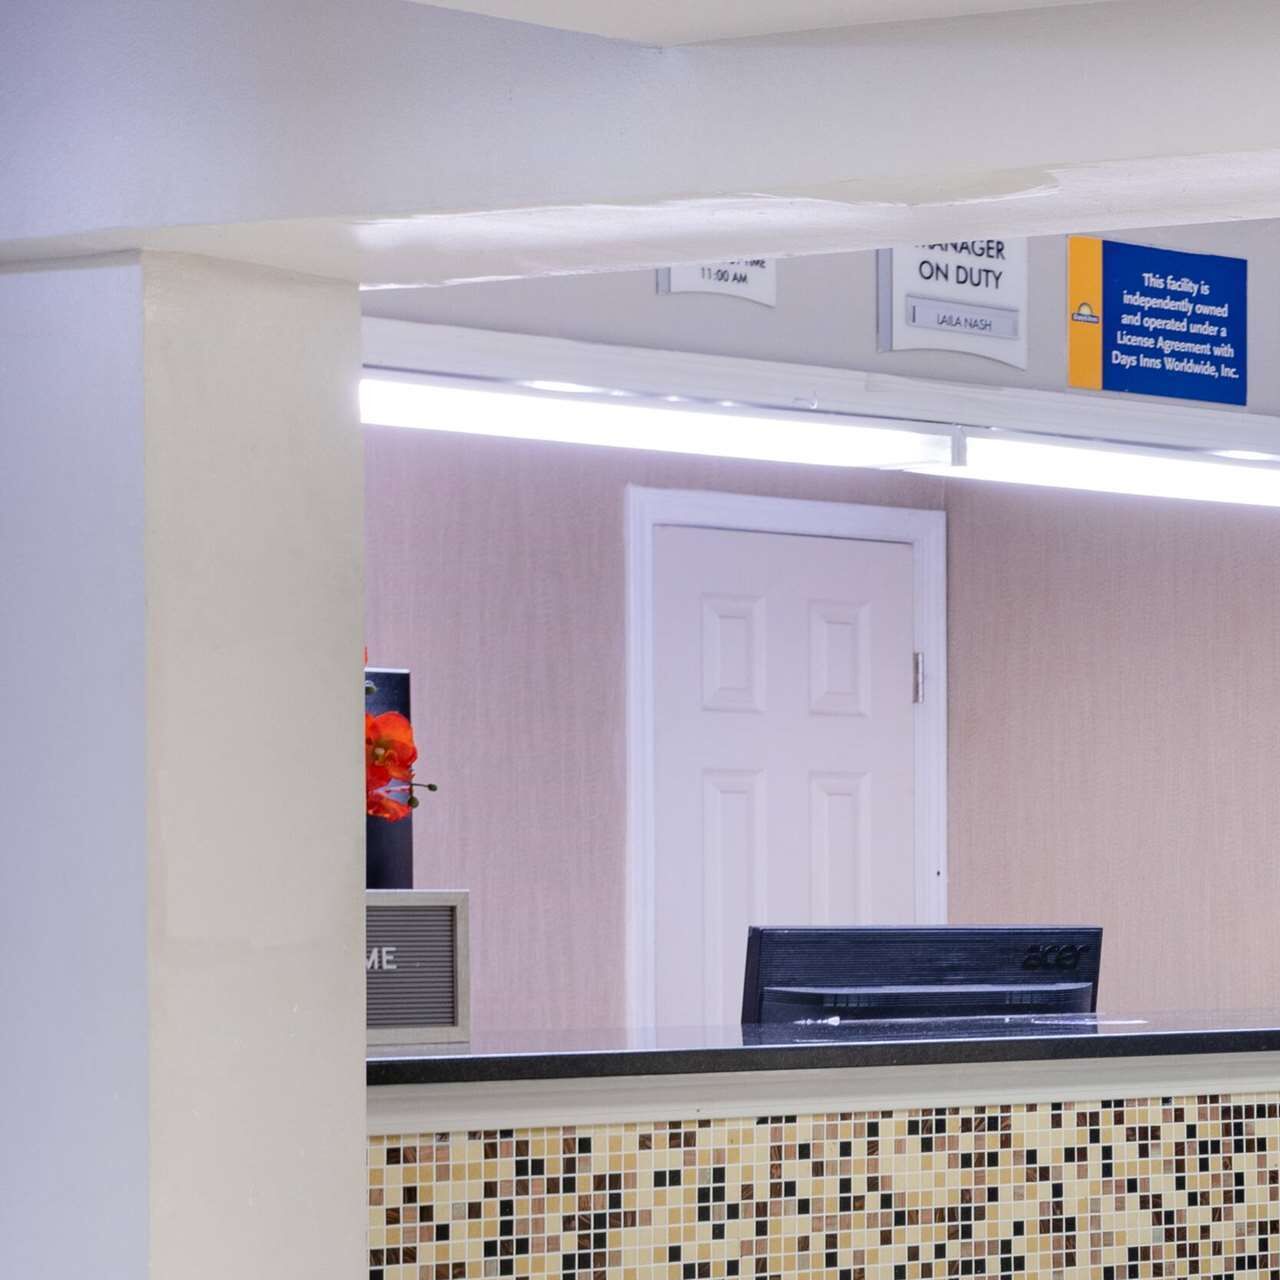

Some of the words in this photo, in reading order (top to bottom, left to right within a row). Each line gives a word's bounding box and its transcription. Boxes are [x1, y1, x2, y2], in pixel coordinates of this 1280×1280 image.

[914, 239, 1005, 260] NAGER
[731, 272, 748, 284] AM
[919, 260, 949, 282] ON
[956, 265, 1003, 289] DUTY
[1142, 272, 1165, 289] This
[1166, 275, 1199, 297] facility
[1200, 281, 1210, 295] is
[1123, 290, 1194, 316] independently
[1195, 303, 1229, 318] owned
[1121, 311, 1141, 326] and
[1143, 317, 1187, 332] operated
[1189, 320, 1218, 336] under
[1220, 326, 1227, 337] a
[1117, 330, 1155, 348] License
[1156, 336, 1211, 354] Agreement
[1213, 343, 1234, 358] with
[1111, 350, 1137, 369] Days
[1139, 354, 1162, 369] Inns
[1163, 356, 1219, 378] Worldwide,
[1220, 364, 1239, 378] Inc.
